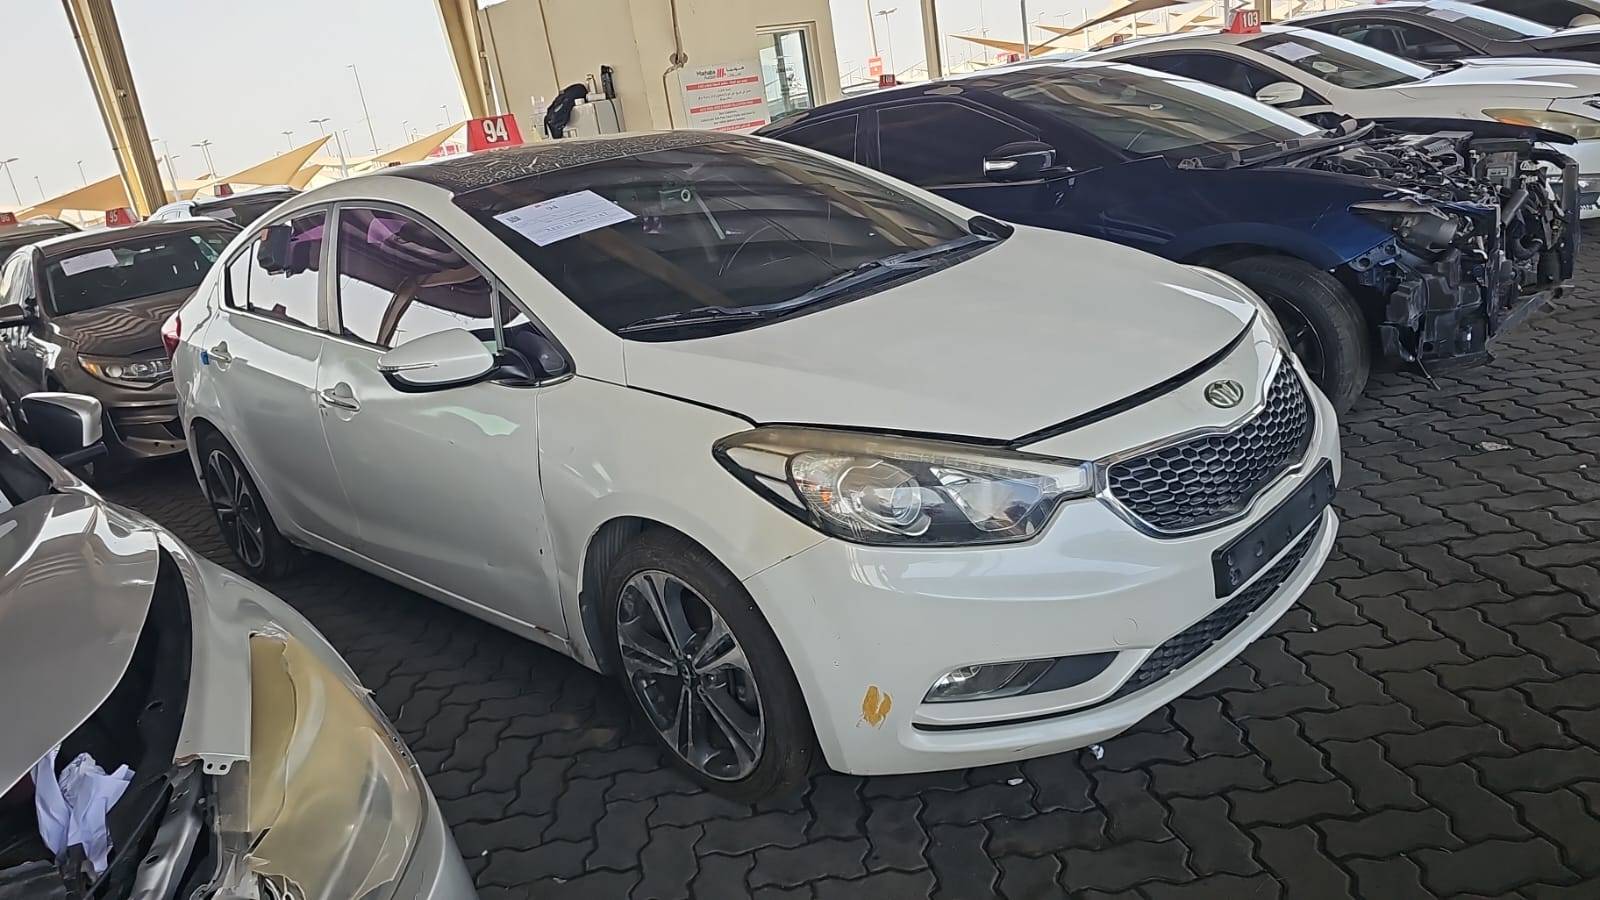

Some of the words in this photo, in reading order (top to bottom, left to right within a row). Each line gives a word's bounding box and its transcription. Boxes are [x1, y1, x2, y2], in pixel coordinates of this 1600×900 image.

[1243, 11, 1259, 28] 103
[482, 118, 508, 143] 94
[109, 209, 118, 224] 95
